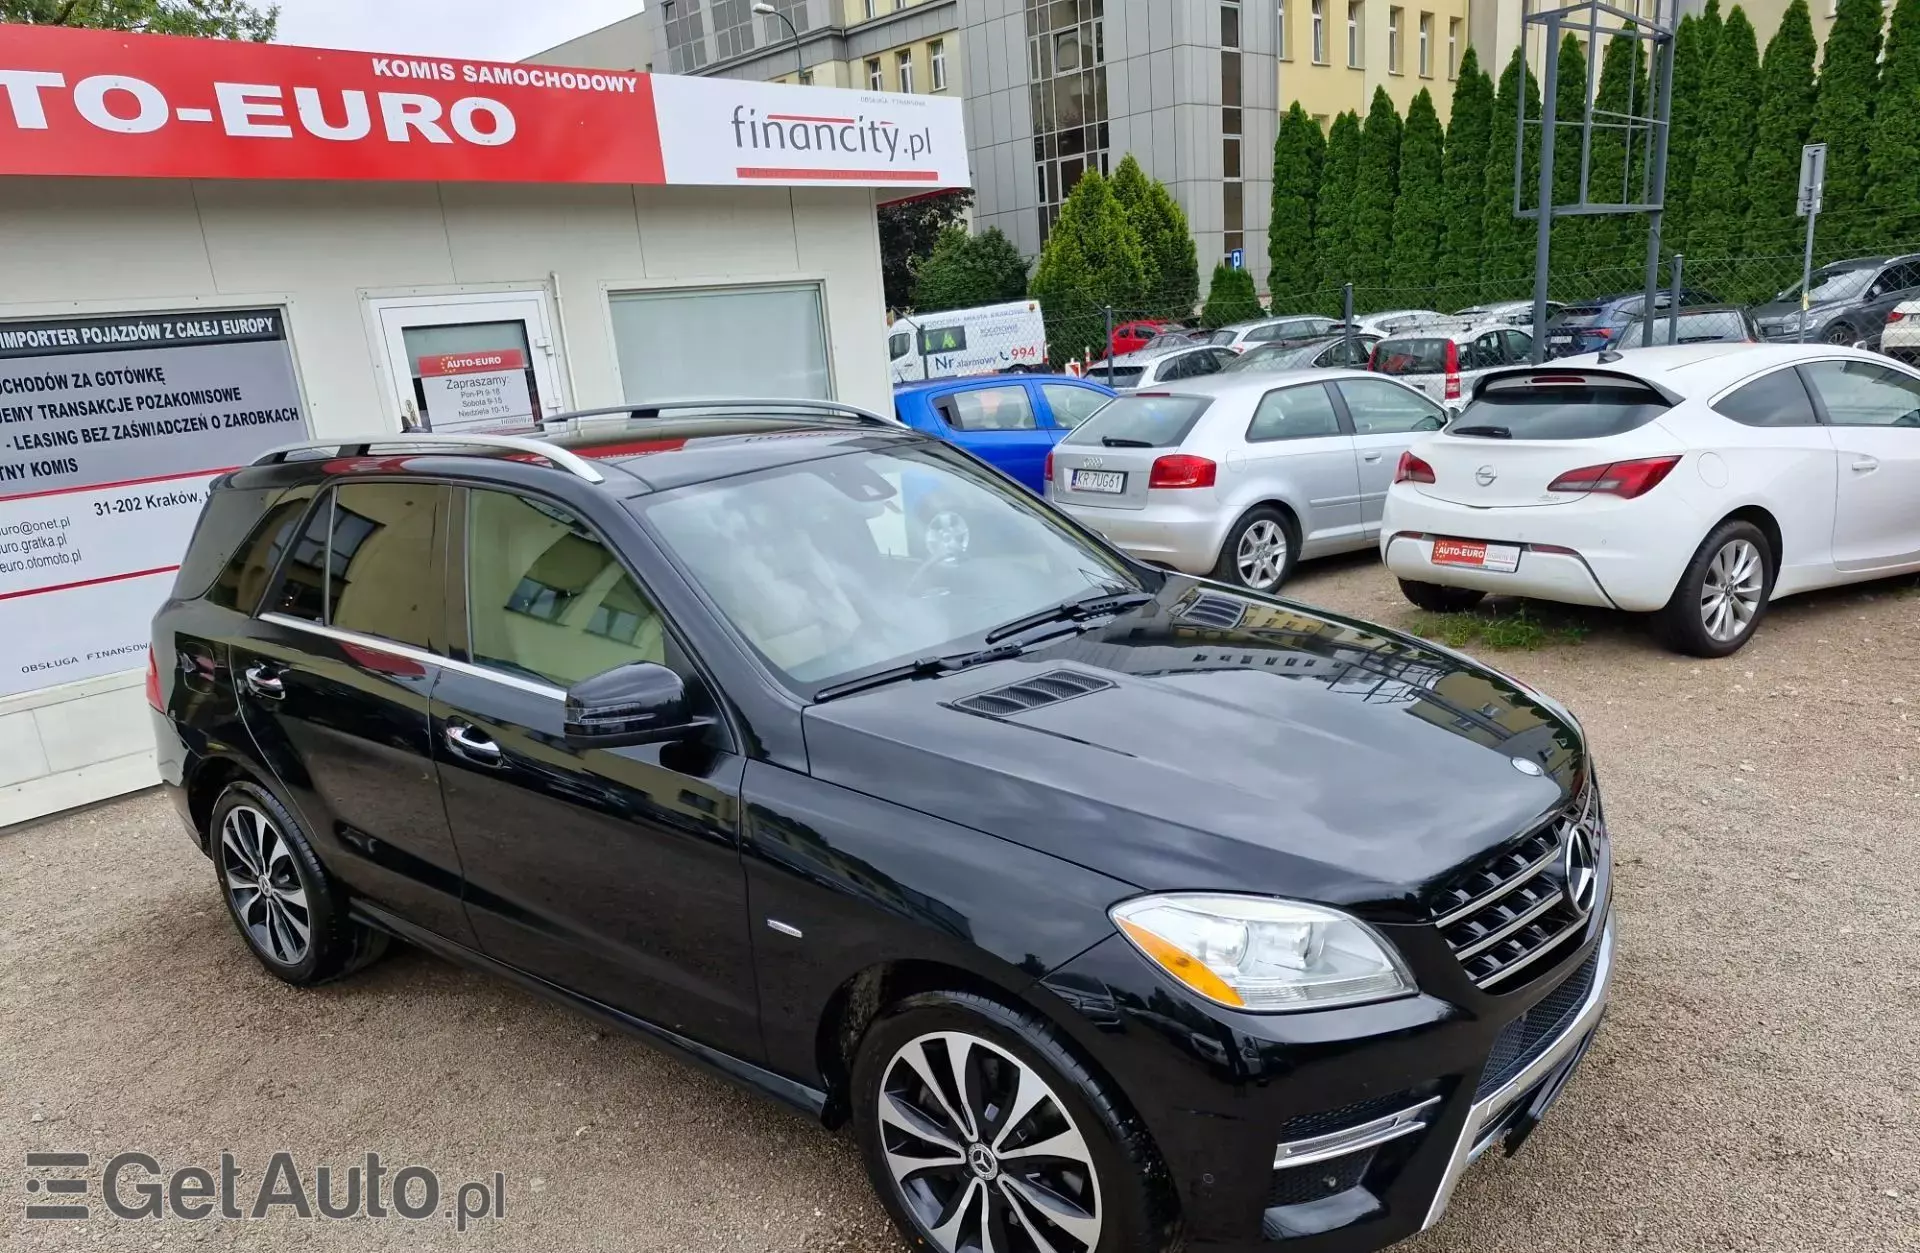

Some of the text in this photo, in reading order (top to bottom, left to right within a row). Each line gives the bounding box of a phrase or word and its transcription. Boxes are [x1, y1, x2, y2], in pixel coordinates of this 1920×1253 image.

[371, 57, 638, 94] KOMIS SAMOCHODOWY
[731, 104, 932, 162] financity.pl
[0, 317, 274, 349] IMPORTER POJAZDÓW Z CAŁEJ EUROPY
[446, 356, 502, 369] AUTO-EURO
[935, 355, 998, 370] Nr alarmowy
[1010, 346, 1037, 361] 994
[71, 372, 94, 390] ZA
[95, 366, 166, 386] GOTÓWKĘ
[38, 401, 135, 421] TRANSAKCJE
[137, 387, 243, 411] POZAKOMISOWE
[458, 405, 510, 417] Niedziela 10-15
[462, 400, 486, 408] Sobota
[13, 429, 79, 451] LEASING
[81, 426, 111, 444] BEZ
[112, 412, 210, 441] ZAŚWIADCZEŃ
[211, 414, 222, 430] O
[223, 407, 300, 428] ZAROBKACH
[30, 457, 80, 478] KOMIS
[1077, 471, 1121, 489] KR 7UG61
[93, 496, 143, 517] 31-202
[145, 490, 203, 509] Kraków,
[0, 516, 71, 536] uro@onet.pl
[1439, 546, 1485, 558] AUTO-EURO
[21, 642, 150, 674] OBSŁUGA FINANSOW
